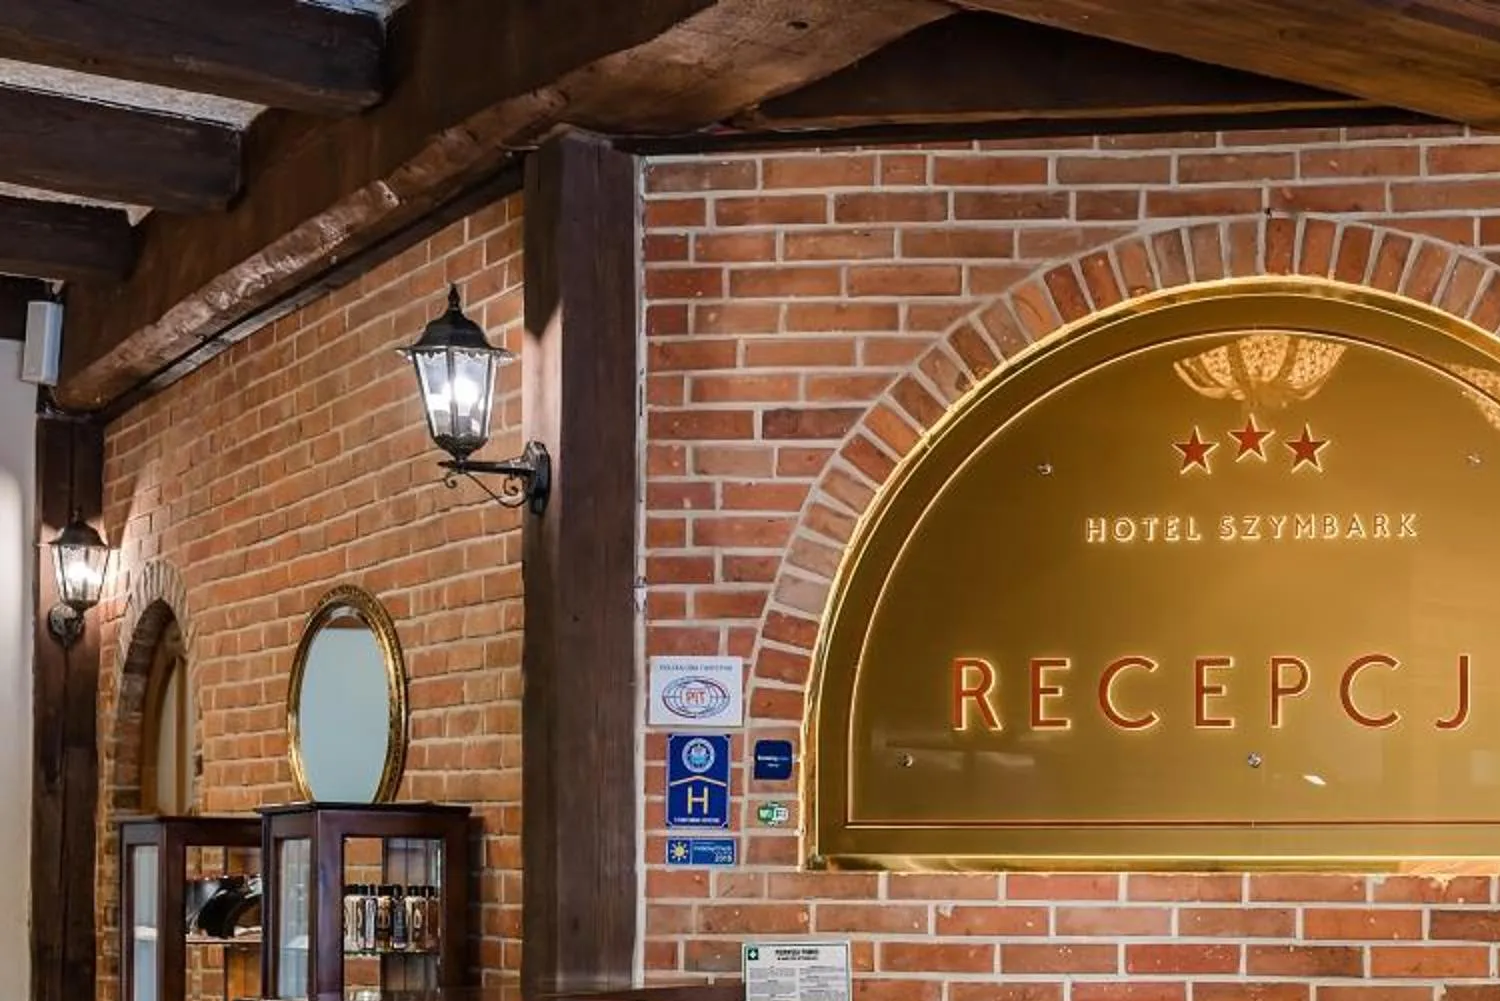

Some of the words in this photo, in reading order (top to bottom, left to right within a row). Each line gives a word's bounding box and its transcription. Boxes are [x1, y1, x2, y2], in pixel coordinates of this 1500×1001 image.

[1086, 516, 1201, 543] HOTEL
[1219, 513, 1419, 541] SZYMBARK
[687, 785, 709, 815] H
